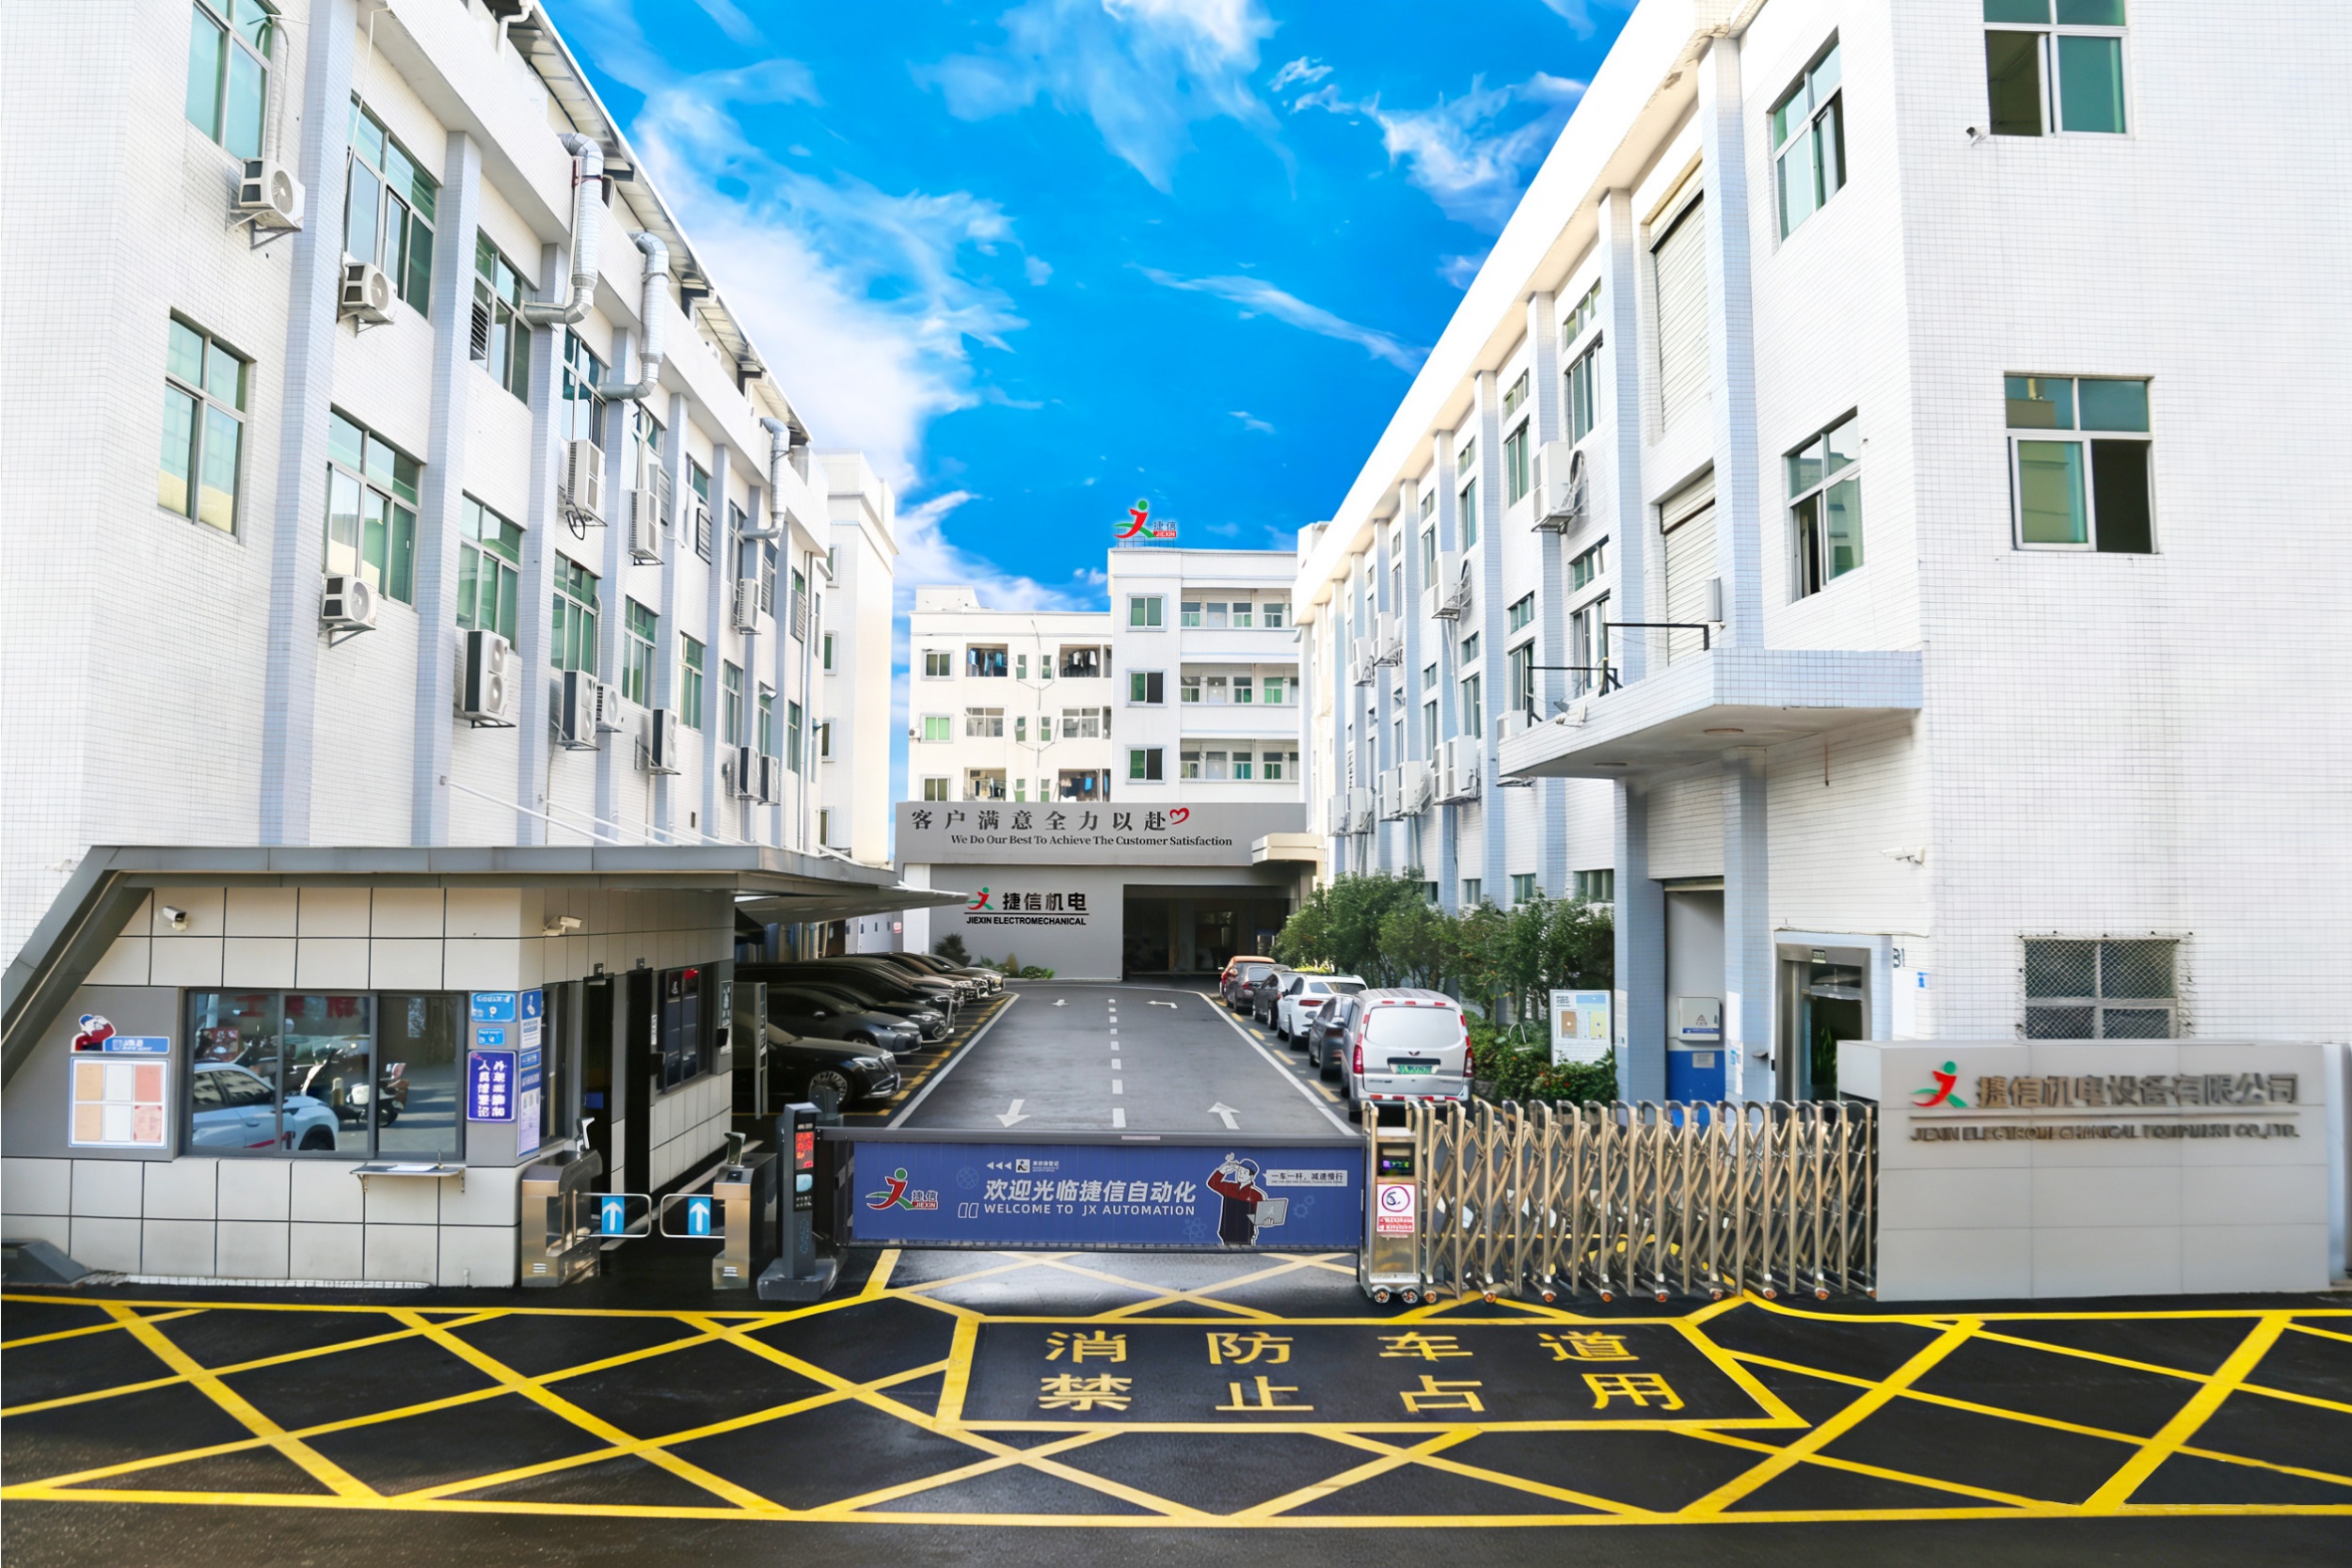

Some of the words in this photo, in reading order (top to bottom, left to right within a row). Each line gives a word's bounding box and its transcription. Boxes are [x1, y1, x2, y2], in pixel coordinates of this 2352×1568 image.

[1153, 521, 1176, 531] 捷信
[912, 809, 1166, 832] 客户满意全力以赴
[951, 834, 968, 845] We
[969, 834, 985, 845] Do
[986, 834, 1008, 845] Our
[1009, 835, 1032, 845] Best
[1033, 835, 1048, 845] To
[1049, 835, 1091, 846] Achieve
[1093, 835, 1114, 845] The
[1116, 836, 1168, 846] Customer
[1169, 835, 1232, 846] Satisfaction
[1003, 892, 1087, 911] 捷信机电
[966, 916, 993, 925] JIEXIN
[993, 916, 1087, 926] ELECTROMECHANICAL
[1976, 1073, 2298, 1108] 捷信机电设备有限公司
[912, 1190, 938, 1202] 捷信
[983, 1179, 1197, 1204] 欢迎光临捷信自动化
[984, 1204, 1051, 1214] WELCOME
[1057, 1204, 1073, 1214] TO
[1082, 1205, 1097, 1217] JX
[1102, 1205, 1196, 1216] AUTOMATION
[1045, 1329, 1640, 1365] 消防车道
[1038, 1372, 1686, 1413] 禁止占用
